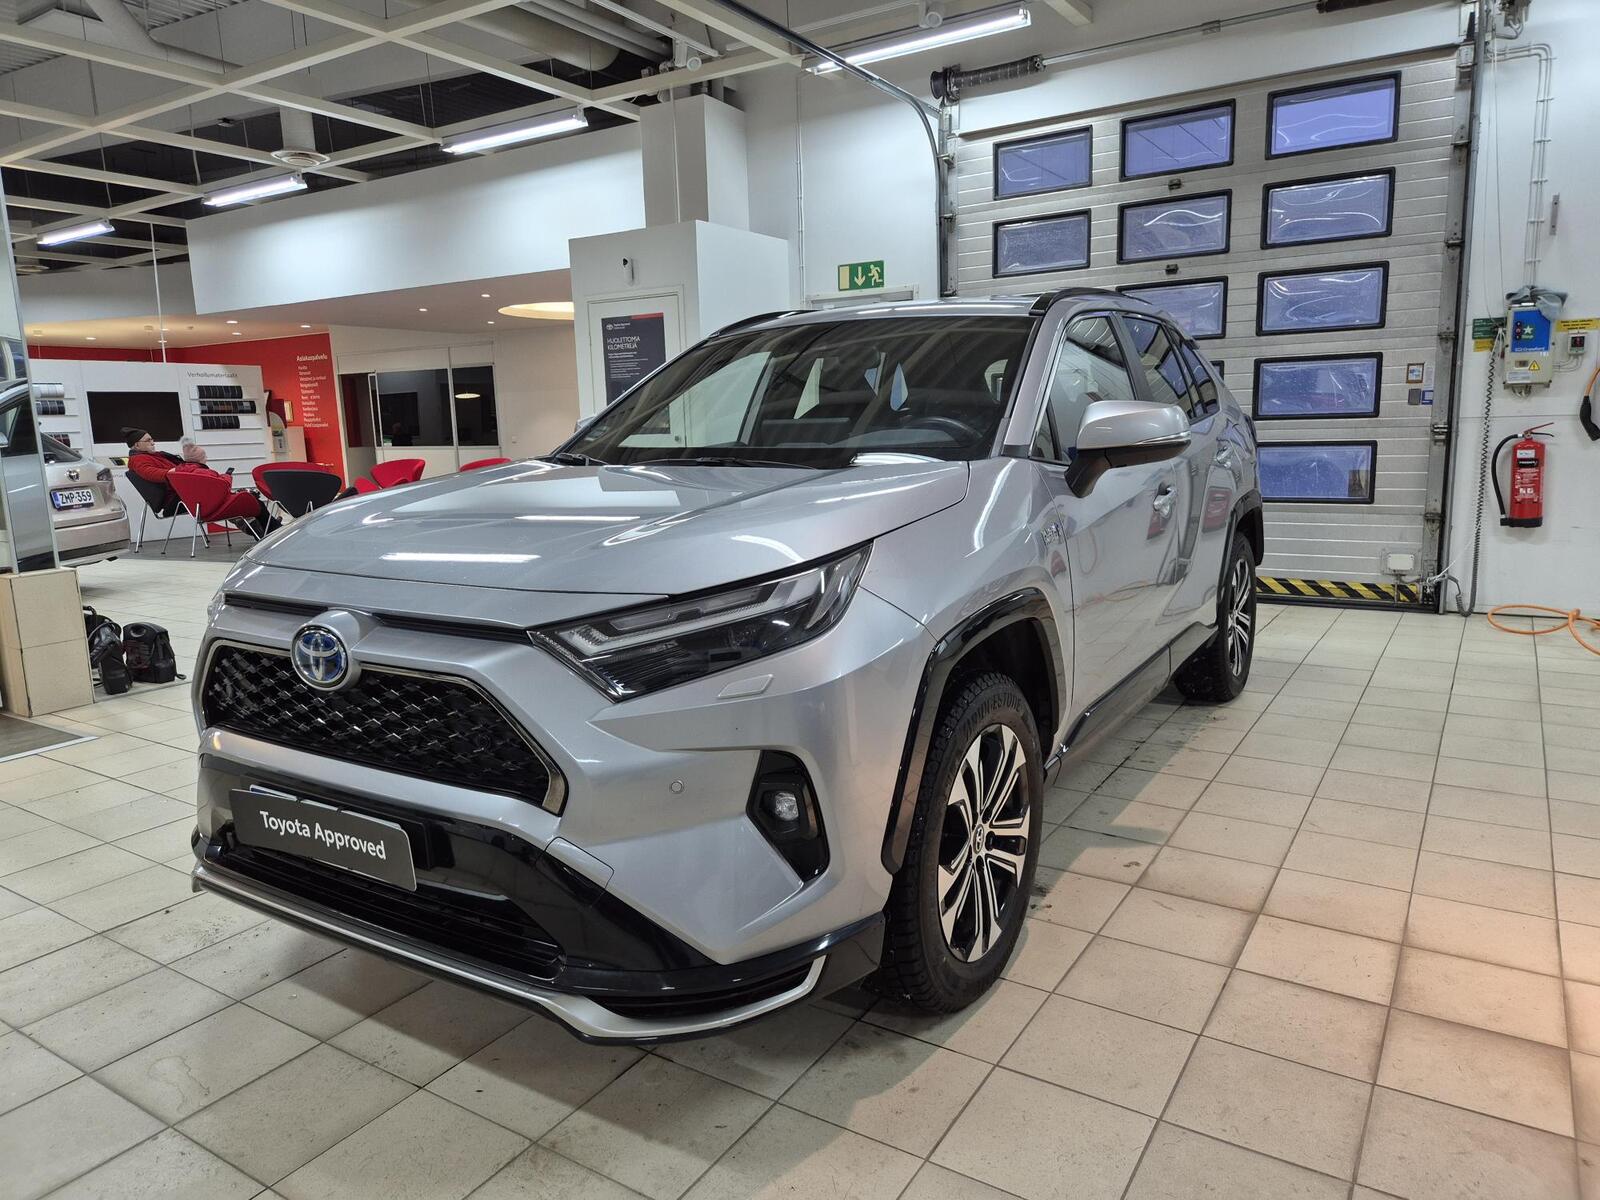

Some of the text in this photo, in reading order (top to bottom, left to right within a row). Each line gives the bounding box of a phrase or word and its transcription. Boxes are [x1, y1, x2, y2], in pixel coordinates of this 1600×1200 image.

[59, 491, 92, 504] ZMP-359
[259, 810, 387, 860] Toyota Approved
